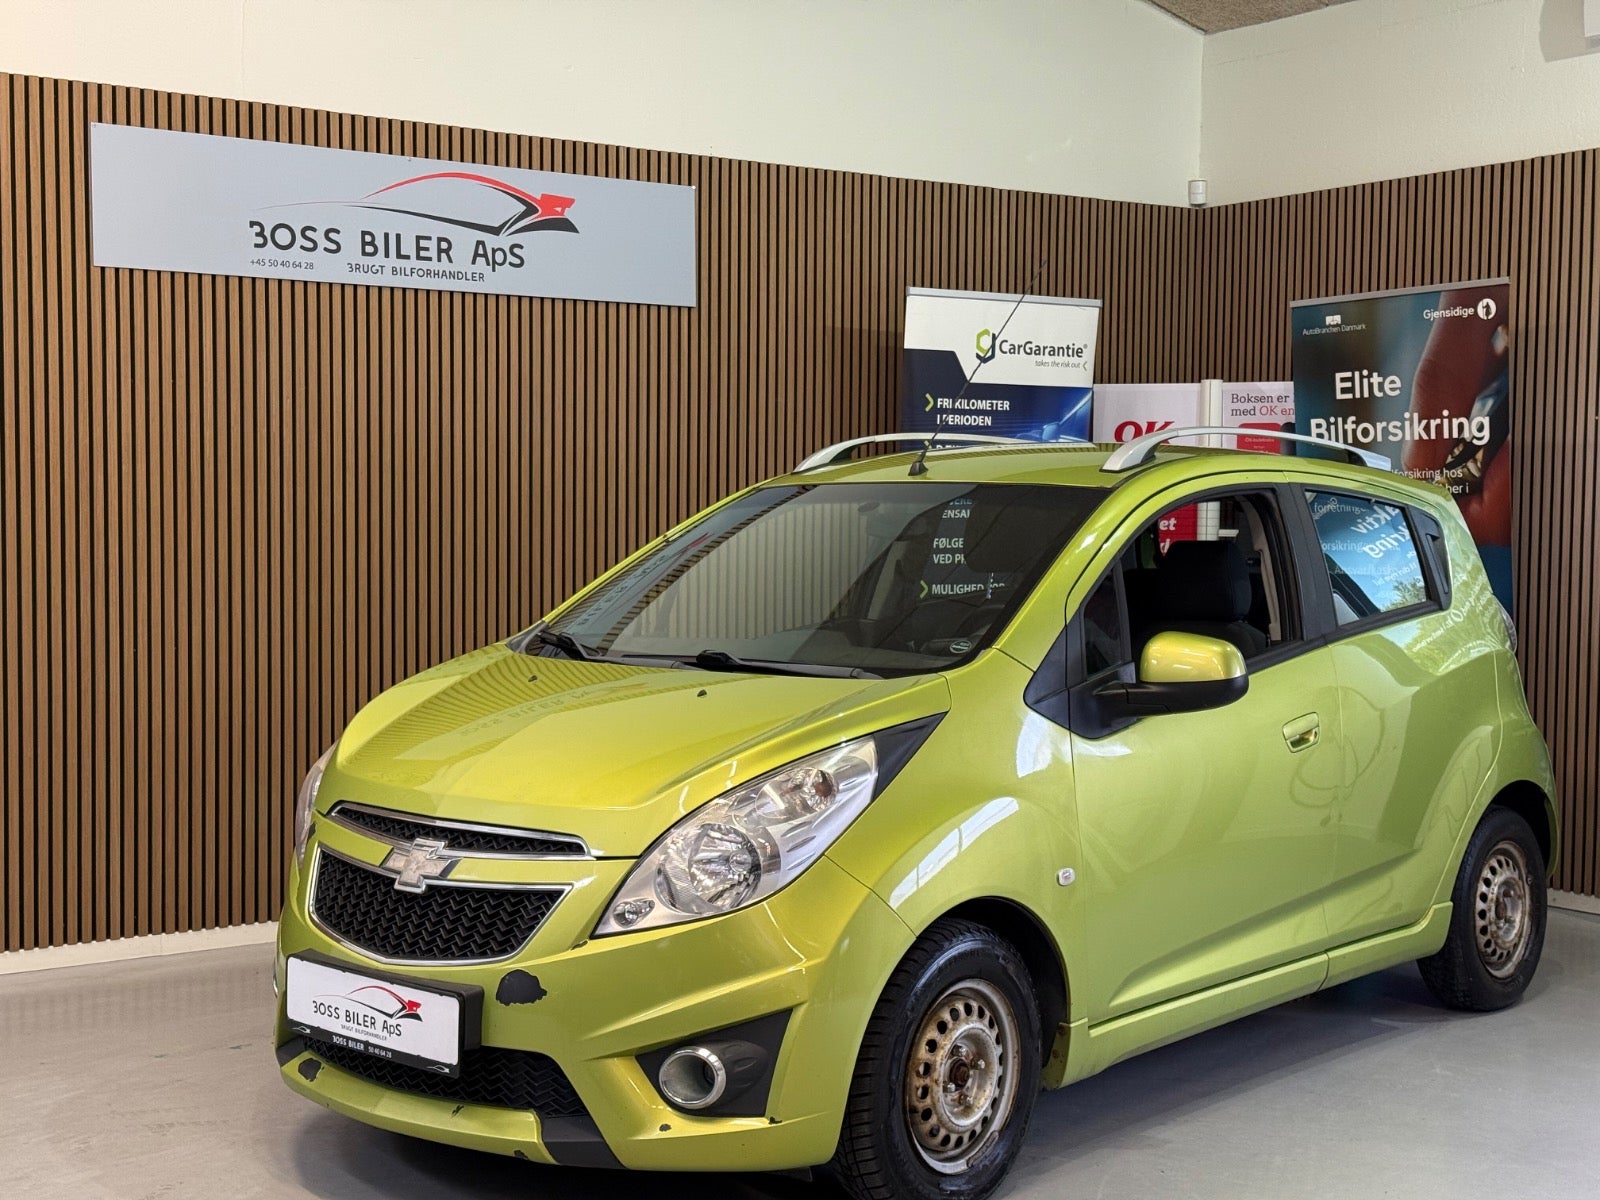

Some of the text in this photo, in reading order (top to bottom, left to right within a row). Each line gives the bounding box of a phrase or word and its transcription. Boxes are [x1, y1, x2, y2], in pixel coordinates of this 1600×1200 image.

[360, 230, 453, 263] BILER
[471, 239, 525, 272] ApS
[250, 259, 314, 270] +45 50 40 64 28
[391, 266, 485, 282] BILFORHANDLER
[1423, 307, 1475, 320] Gjensidige
[1341, 324, 1366, 332] Danmark
[1051, 360, 1060, 368] the
[1335, 369, 1402, 400] Elite
[937, 398, 1010, 411] FRI KILOMETER
[1231, 393, 1290, 404] Boksen er
[1231, 406, 1256, 416] med
[1259, 406, 1278, 416] OK
[1114, 420, 1175, 444] OK
[1310, 409, 1491, 446] Bilforsikring
[1443, 467, 1463, 478] hos
[933, 553, 953, 564] VED
[345, 1009, 376, 1031] BILER
[381, 1020, 402, 1037] ApS
[348, 1040, 365, 1051] BILER
